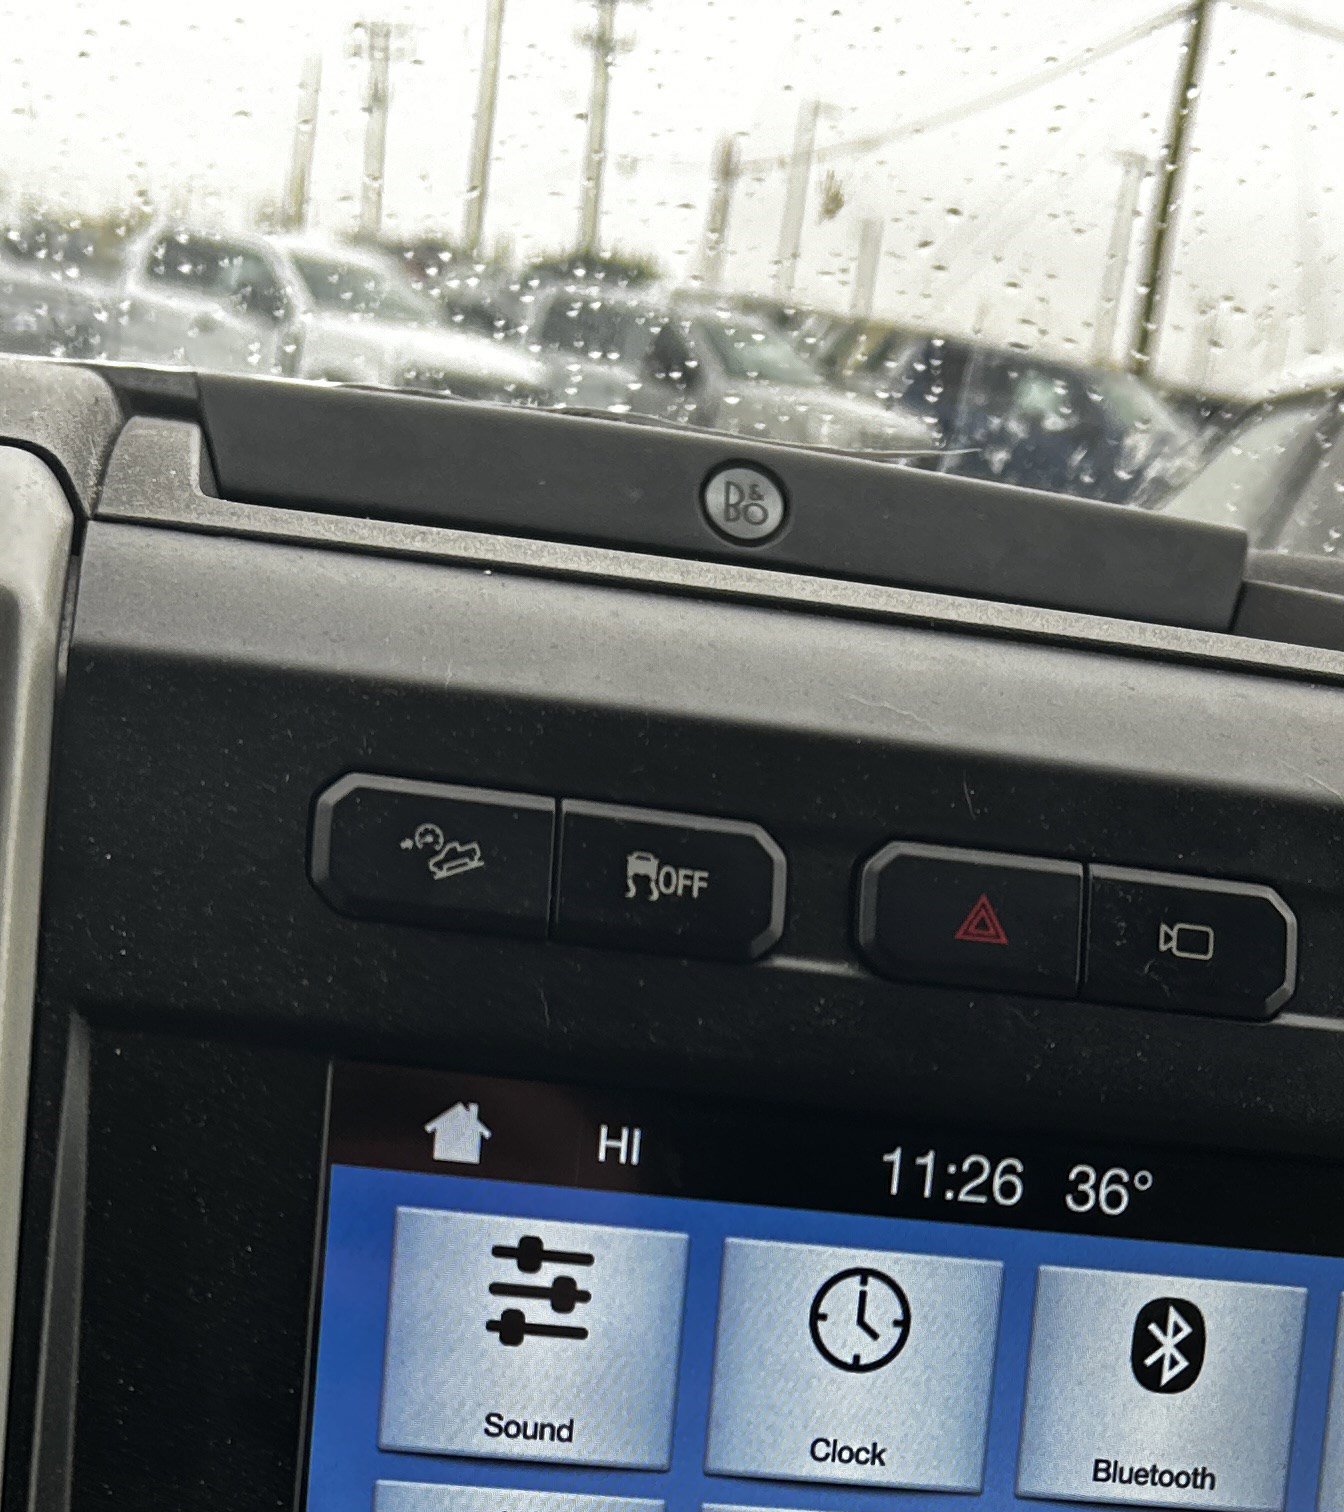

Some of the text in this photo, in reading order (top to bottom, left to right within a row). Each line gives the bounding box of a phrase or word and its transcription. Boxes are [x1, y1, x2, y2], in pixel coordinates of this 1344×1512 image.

[658, 865, 709, 899] OFF
[598, 1125, 641, 1166] HI
[882, 1147, 1153, 1216] 11:26 36°
[483, 1412, 575, 1443] Sound
[809, 1437, 886, 1467] Clock
[1092, 1458, 1216, 1491] Bluetooth
